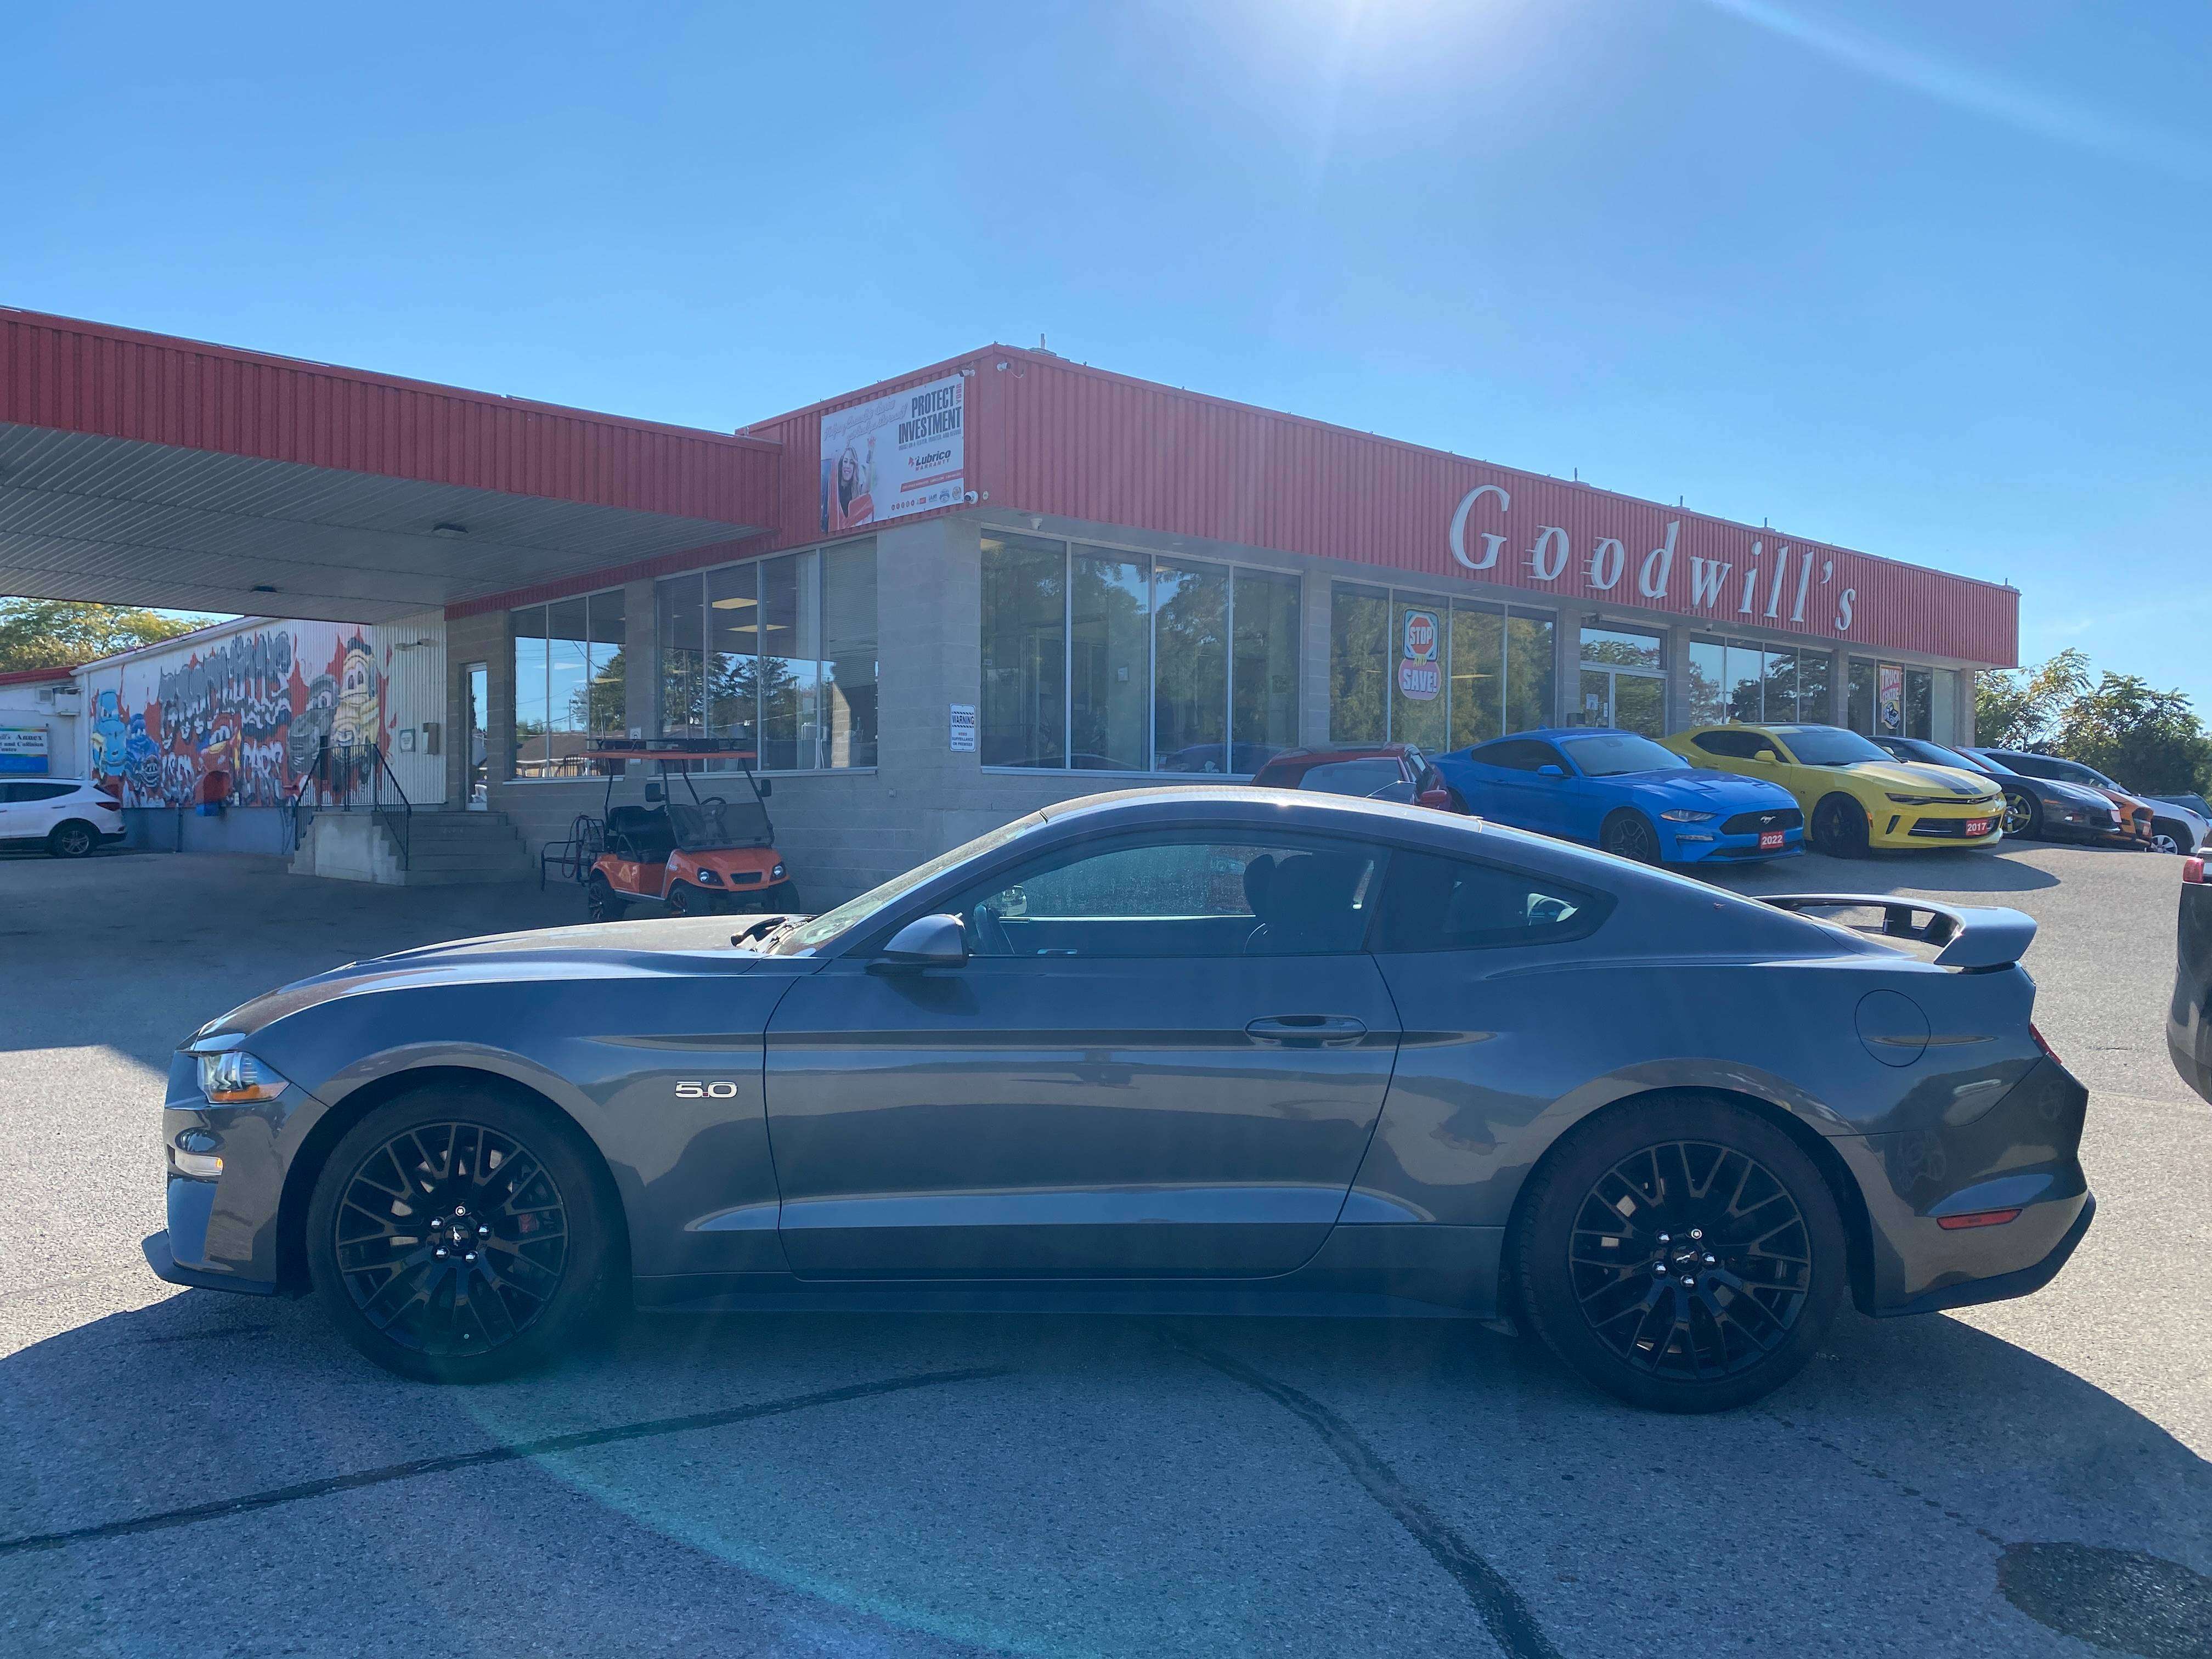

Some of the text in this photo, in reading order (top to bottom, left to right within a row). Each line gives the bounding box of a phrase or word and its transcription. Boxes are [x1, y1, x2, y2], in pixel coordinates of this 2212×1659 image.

[912, 385, 955, 417] PROTECT
[899, 407, 961, 444] INVESTMENT
[915, 450, 951, 466] Lubrico
[916, 459, 950, 471] WARRANTY
[1449, 484, 1856, 631] Goodwill's
[1410, 627, 1432, 645] STOP
[1403, 669, 1437, 693] SAVE!
[952, 715, 974, 725] WARNING
[1967, 822, 1987, 832] 2017
[1762, 835, 1782, 845] 2022
[675, 1081, 737, 1098] 5.0
